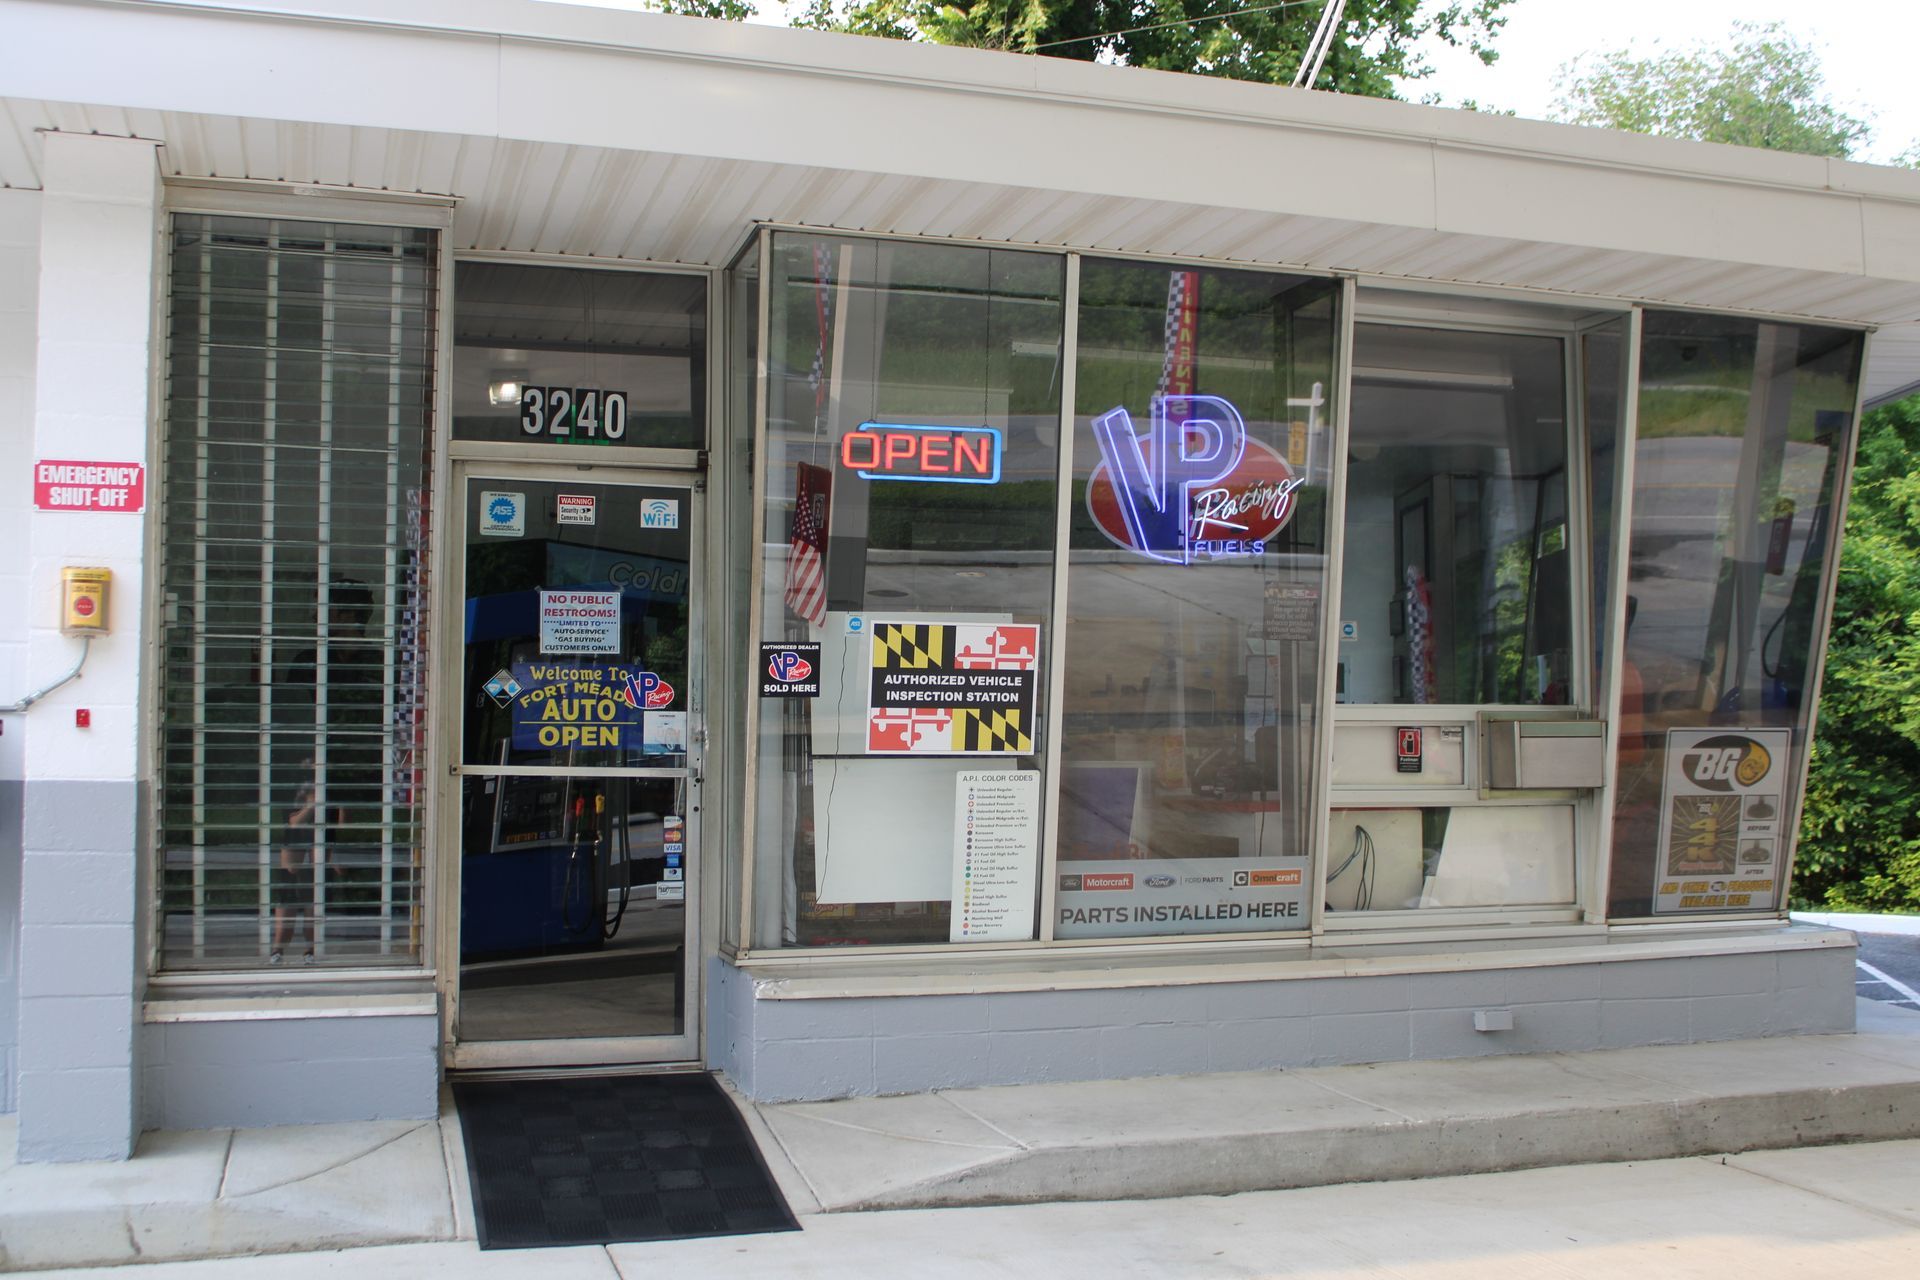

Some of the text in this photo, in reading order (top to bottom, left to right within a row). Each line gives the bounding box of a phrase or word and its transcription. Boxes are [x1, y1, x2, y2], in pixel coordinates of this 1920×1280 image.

[522, 388, 625, 439] 3240
[842, 432, 989, 474] OPEN
[39, 465, 140, 486] EMERGENCY
[1090, 395, 1246, 566] VP
[49, 486, 129, 507] SHUT-OFF
[561, 497, 593, 506] WARNING
[492, 505, 513, 515] ASE
[561, 506, 579, 514] Security
[1190, 477, 1305, 540] Racing
[643, 513, 676, 527] WiFi
[1194, 541, 1264, 557] FUELS
[609, 561, 680, 593] Cold
[548, 595, 613, 605] NO PUBLIC
[544, 608, 616, 617] RESTROOMS!
[530, 666, 628, 681] Welcome To
[770, 652, 799, 682] VP
[764, 684, 816, 692] SOLD HERE
[884, 675, 1022, 686] AUTHORIZED VEHICLE
[520, 683, 568, 708] FORT
[625, 672, 661, 708] VP
[647, 691, 673, 704] Racing
[886, 691, 1019, 702] INSPECTION STATION
[542, 698, 616, 722] AUTO
[538, 726, 619, 747] OPEN
[1694, 748, 1743, 781] BG
[1087, 878, 1129, 887] Motorcraft
[1252, 873, 1298, 883] Omnicraft
[1060, 902, 1298, 924] PARTS INSTALLED HERE
